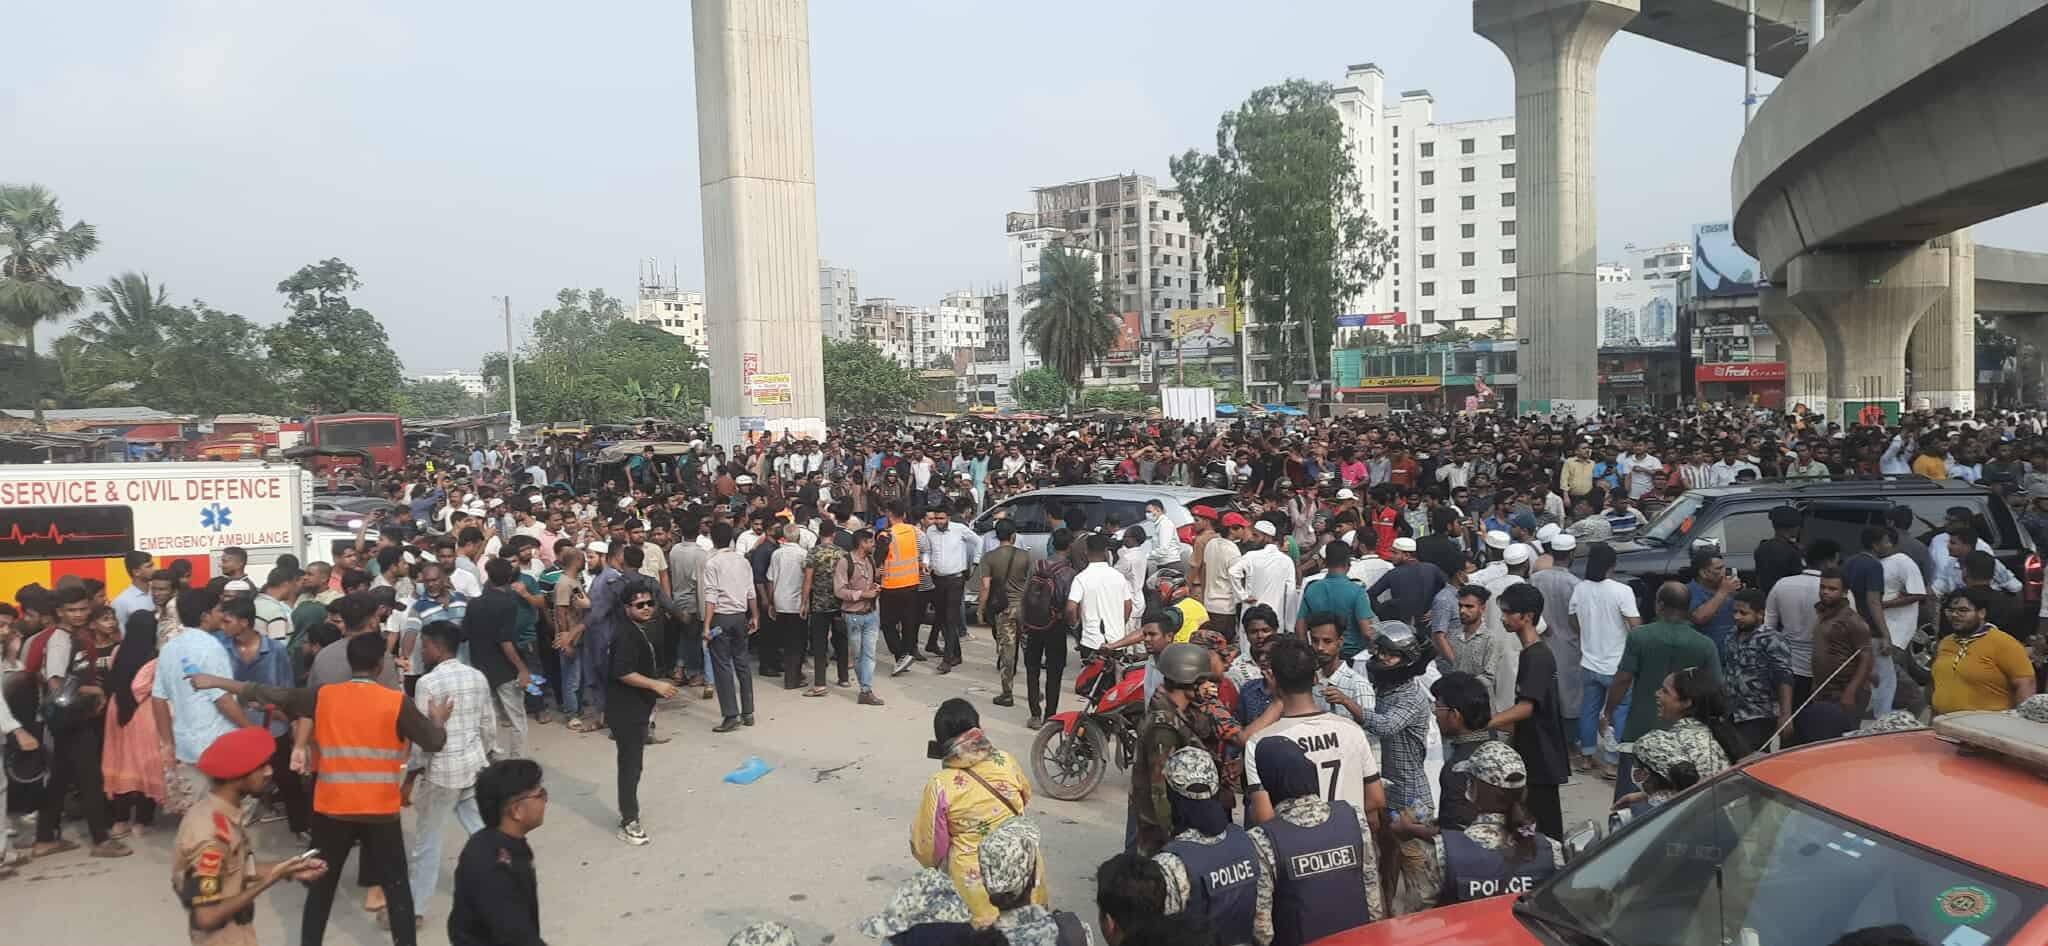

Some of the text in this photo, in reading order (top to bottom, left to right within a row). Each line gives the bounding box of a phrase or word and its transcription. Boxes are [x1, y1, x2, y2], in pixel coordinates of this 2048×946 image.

[1725, 366, 1750, 377] Fresh
[1, 478, 281, 505] SERVICE & CIVIL DEFENCE
[140, 530, 289, 550] EMERGENCY AMBULANCE
[1298, 732, 1340, 753] SIAM
[1321, 759, 1341, 802] 7
[1298, 850, 1353, 873] POLICE
[1210, 859, 1255, 888] POLICE
